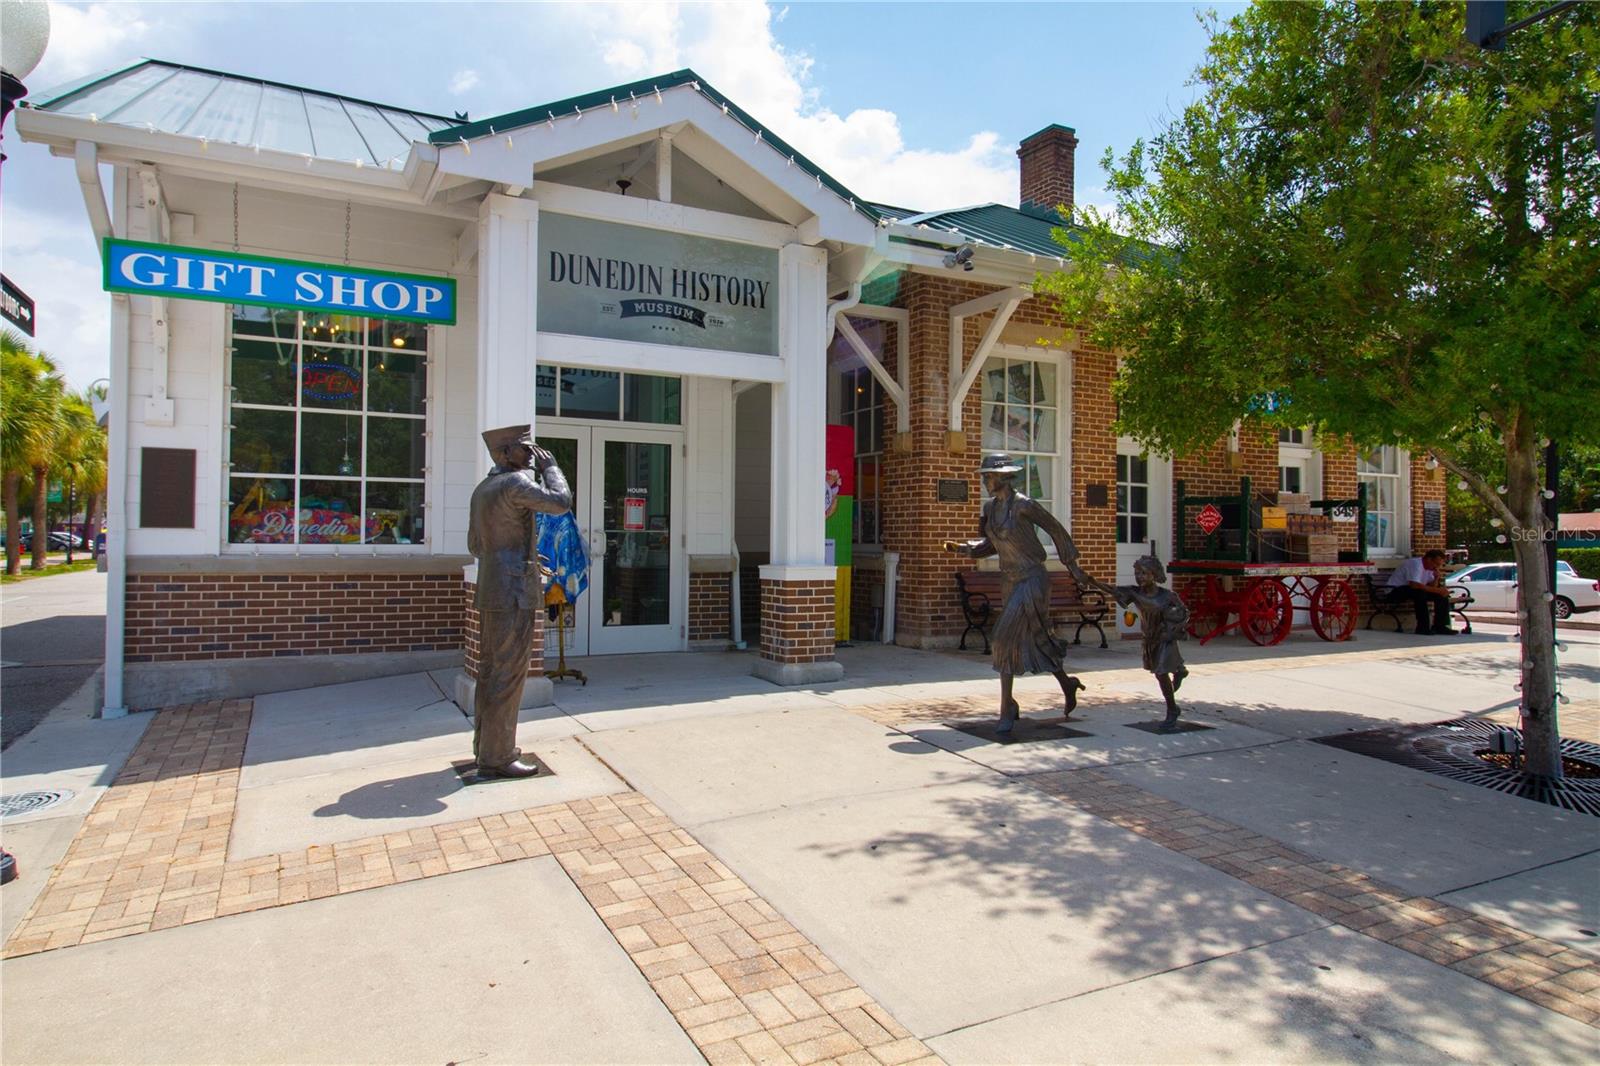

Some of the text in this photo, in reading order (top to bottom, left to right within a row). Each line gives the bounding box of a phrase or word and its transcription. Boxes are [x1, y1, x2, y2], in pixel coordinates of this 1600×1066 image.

[120, 253, 443, 314] GIFT SHOP
[549, 251, 770, 309] DUNEDIN HISTORY
[634, 302, 695, 320] MUSEUM
[253, 512, 350, 536] Dunedin
